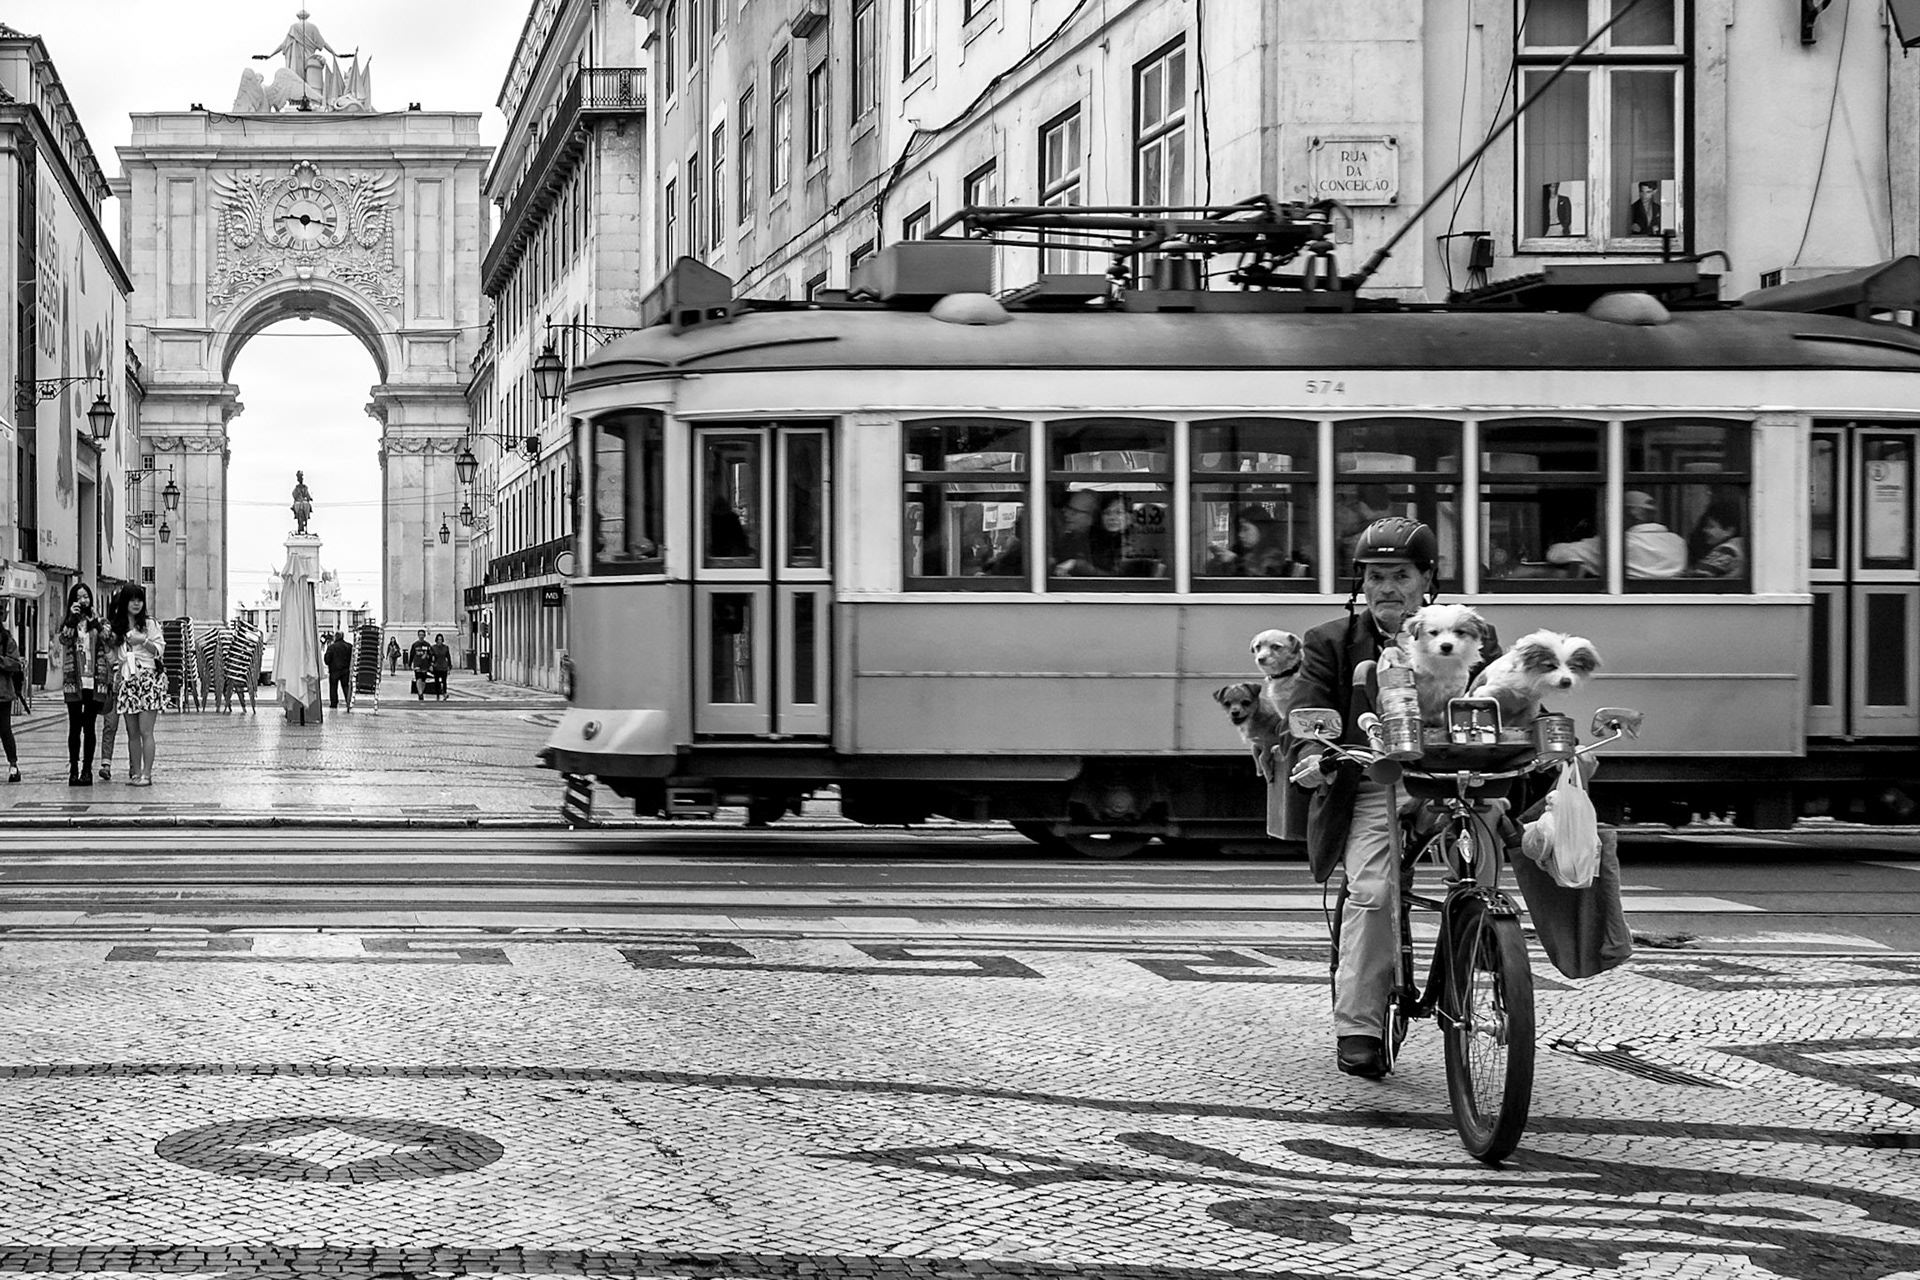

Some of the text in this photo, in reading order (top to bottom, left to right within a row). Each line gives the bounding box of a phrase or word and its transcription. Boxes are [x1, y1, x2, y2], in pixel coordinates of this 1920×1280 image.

[1341, 150, 1367, 162] RUA
[1346, 165, 1362, 176] DA
[38, 215, 60, 280] MUSEU
[38, 262, 60, 325] DESIGN
[38, 310, 57, 364] MODA
[1305, 380, 1345, 394] 574
